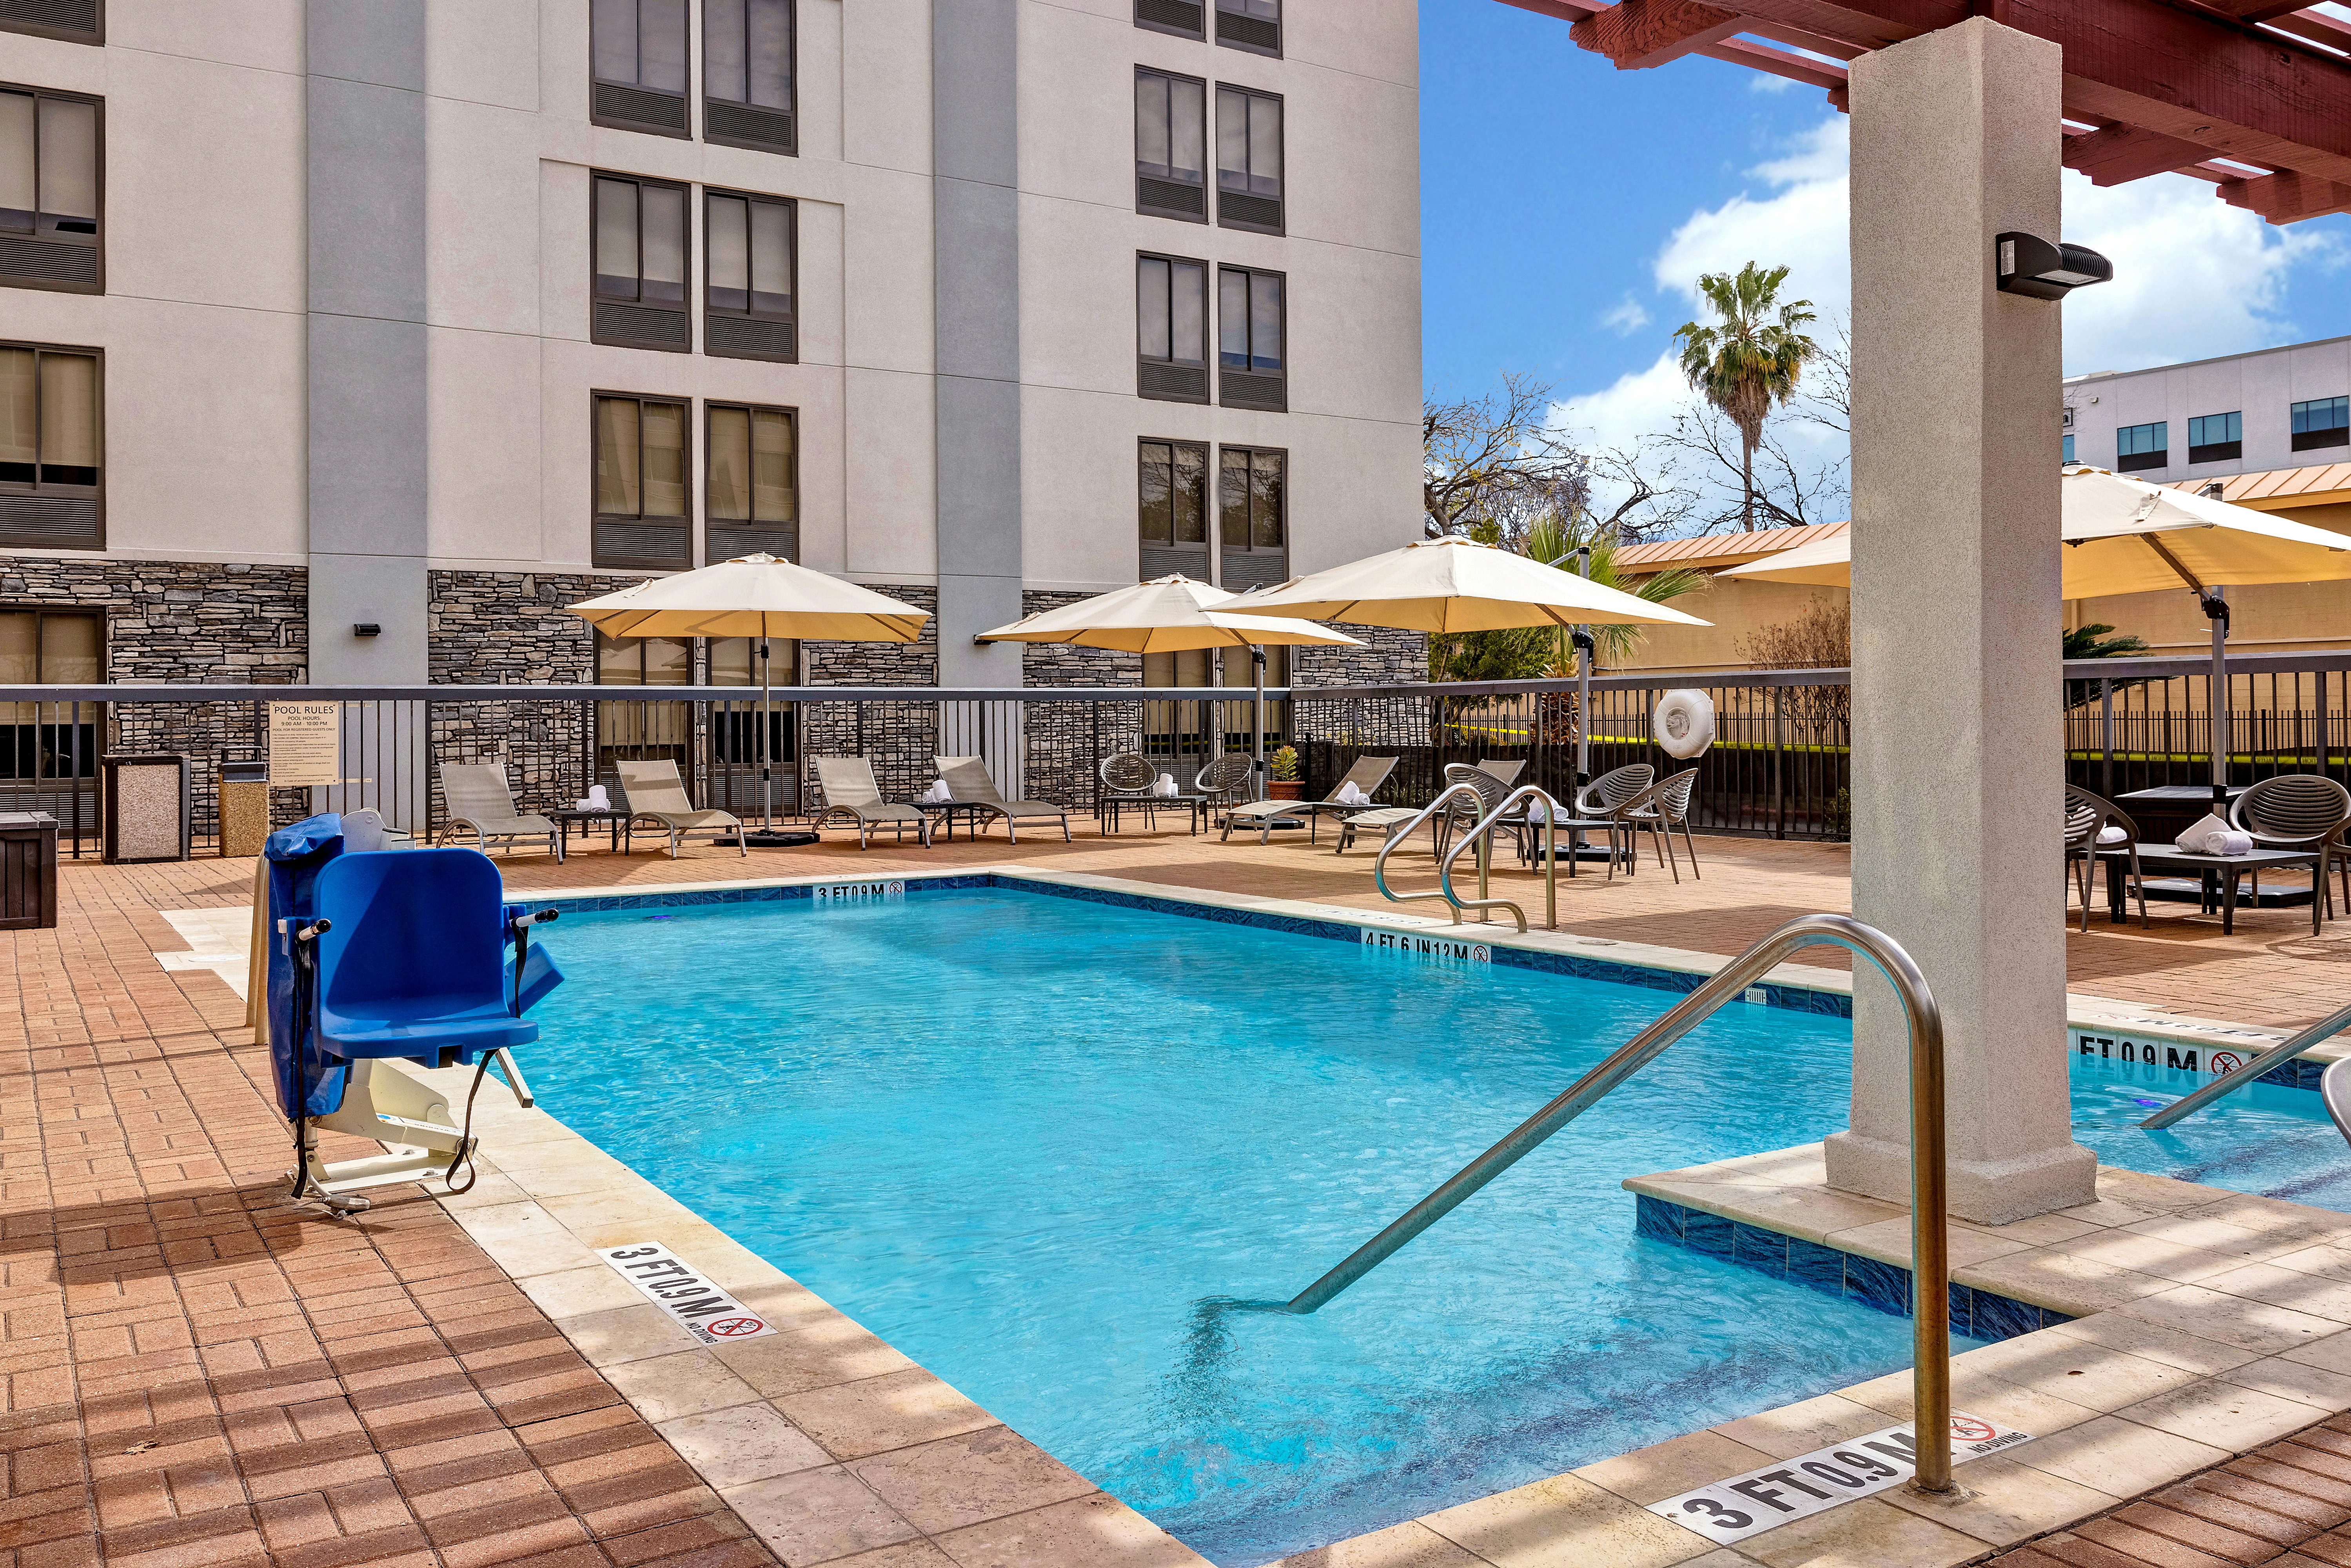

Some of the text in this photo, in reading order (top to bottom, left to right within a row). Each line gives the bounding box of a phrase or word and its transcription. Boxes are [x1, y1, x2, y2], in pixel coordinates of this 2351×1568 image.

[871, 884, 884, 894] M
[1366, 932, 1373, 944] 4
[1379, 933, 1395, 948] FT
[1401, 937, 1409, 950] 6
[1416, 938, 1430, 954] IN
[1454, 944, 1468, 960] M
[2080, 1035, 2113, 1058] FT
[2167, 1047, 2197, 1072] M
[610, 1248, 659, 1259] 3
[670, 1296, 736, 1319] M
[684, 1322, 719, 1344] NO DIVING
[1968, 1432, 2028, 1454] NO DIVING
[1683, 1499, 1753, 1528] 3
